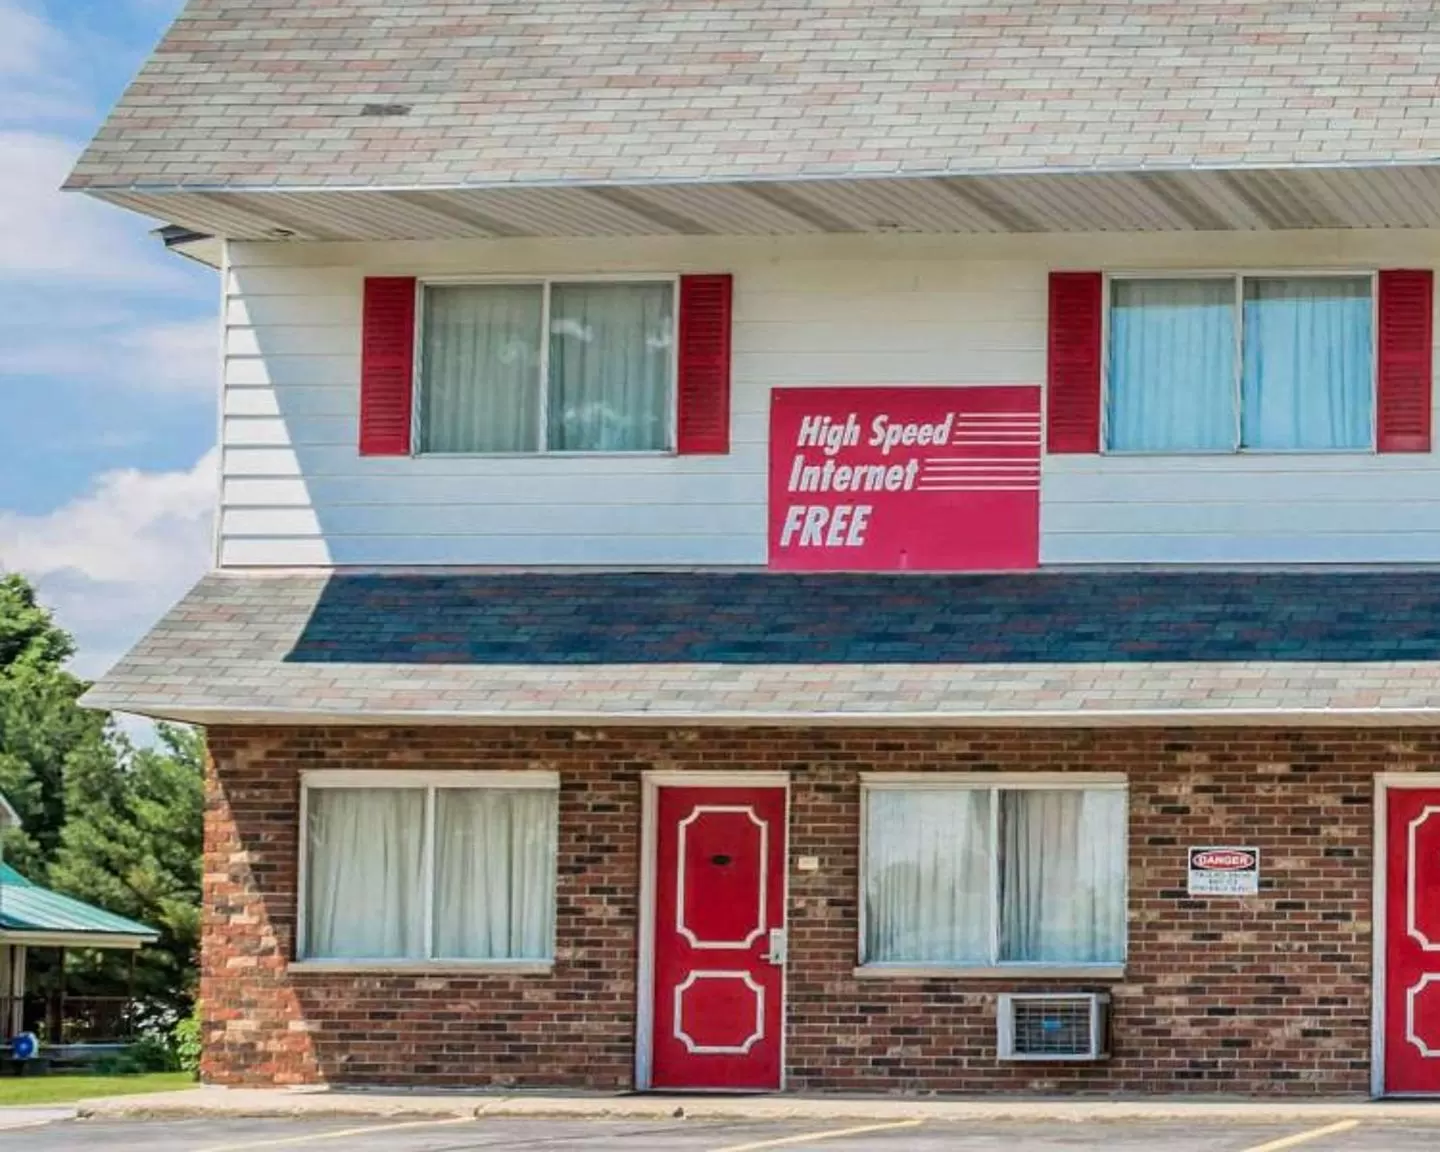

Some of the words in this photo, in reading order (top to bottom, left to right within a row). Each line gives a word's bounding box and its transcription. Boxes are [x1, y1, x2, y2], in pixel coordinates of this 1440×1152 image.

[797, 413, 861, 455] High
[868, 412, 955, 455] Speed
[788, 454, 919, 492] Internet
[779, 505, 873, 547] FREE
[1199, 855, 1248, 866] DANGER
